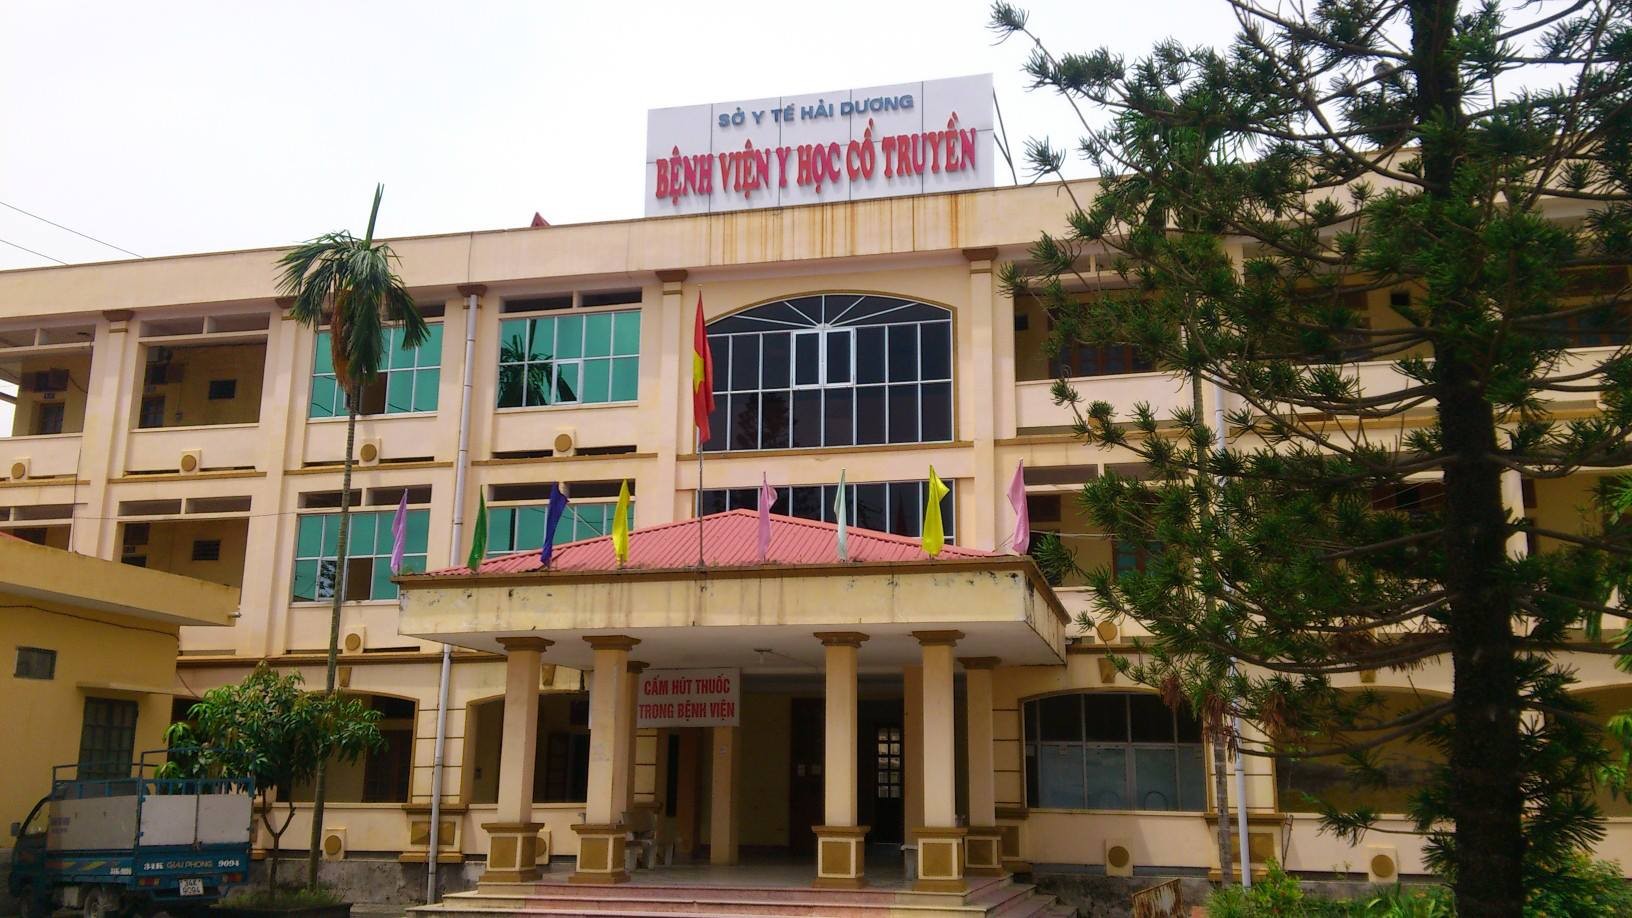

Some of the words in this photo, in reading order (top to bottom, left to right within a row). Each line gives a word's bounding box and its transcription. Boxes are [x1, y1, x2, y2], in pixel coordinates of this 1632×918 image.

[718, 106, 745, 128] SỞ
[752, 111, 765, 125] Y
[771, 103, 795, 123] TẾ
[801, 99, 833, 120] HẢI
[840, 94, 914, 116] DƯƠNG
[655, 145, 714, 206] BỆNH
[719, 138, 772, 200] VIỆN
[776, 146, 791, 188] Y
[796, 142, 841, 193] HỌC
[846, 118, 875, 182] CỔ
[882, 111, 977, 178] TRUYỀN
[644, 674, 668, 695] CẤM
[672, 676, 692, 695] HÚT
[696, 673, 730, 694] THUỐC
[639, 703, 674, 719] TRONG
[677, 700, 707, 722] BỆNH
[710, 699, 735, 720] VIỆN
